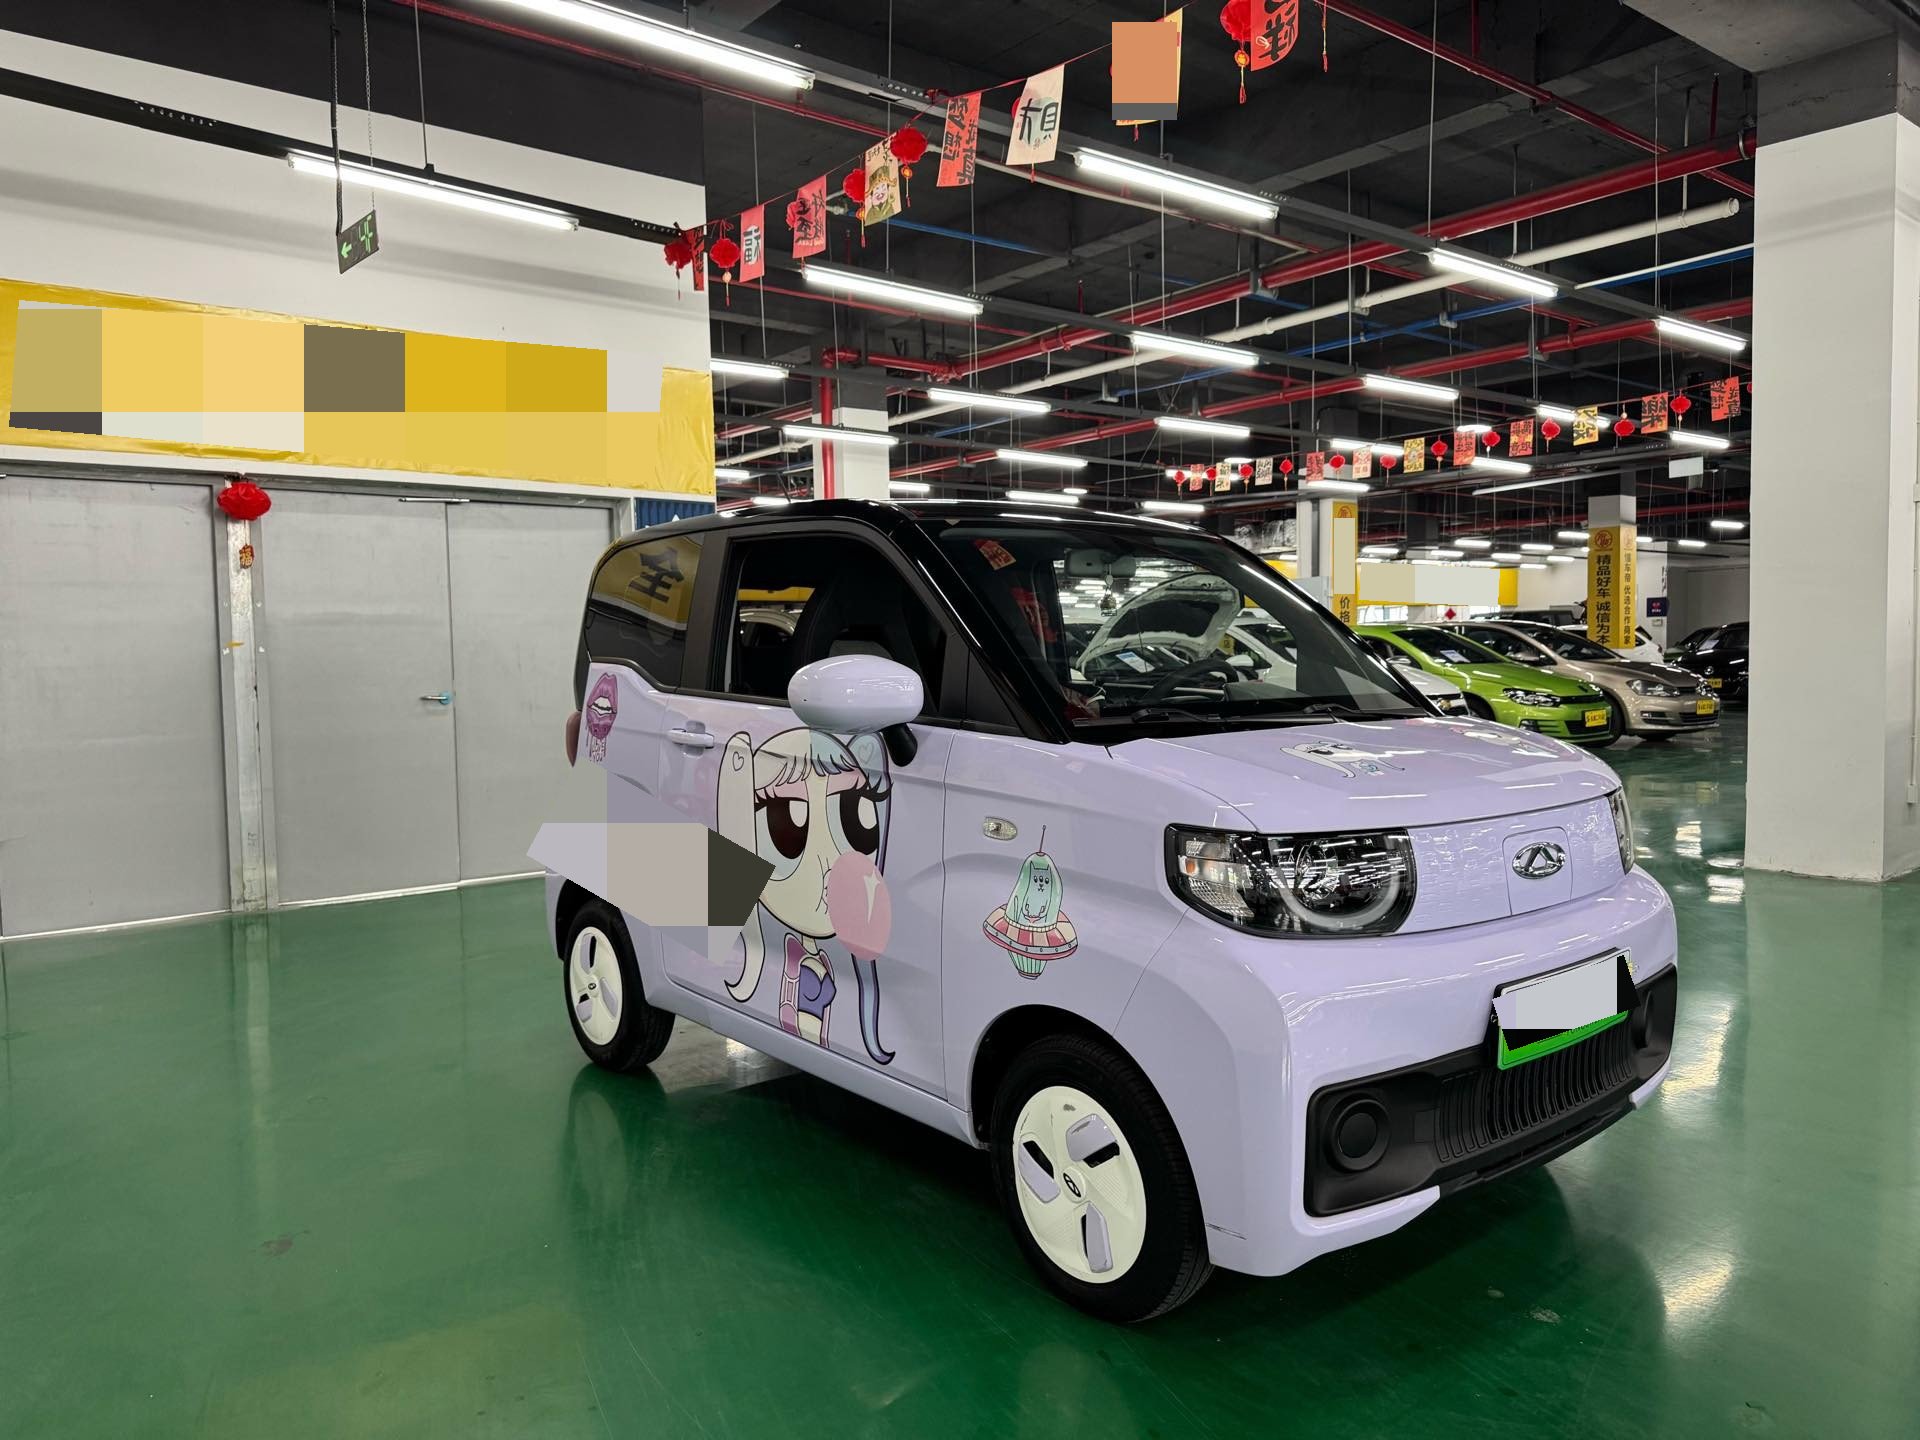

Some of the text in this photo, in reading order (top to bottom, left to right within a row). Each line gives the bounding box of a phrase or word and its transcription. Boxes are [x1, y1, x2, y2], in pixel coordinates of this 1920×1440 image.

[1596, 555, 1611, 598] 精品好车
[1340, 595, 1350, 622] 价格
[1596, 601, 1611, 645] 诚信为本
